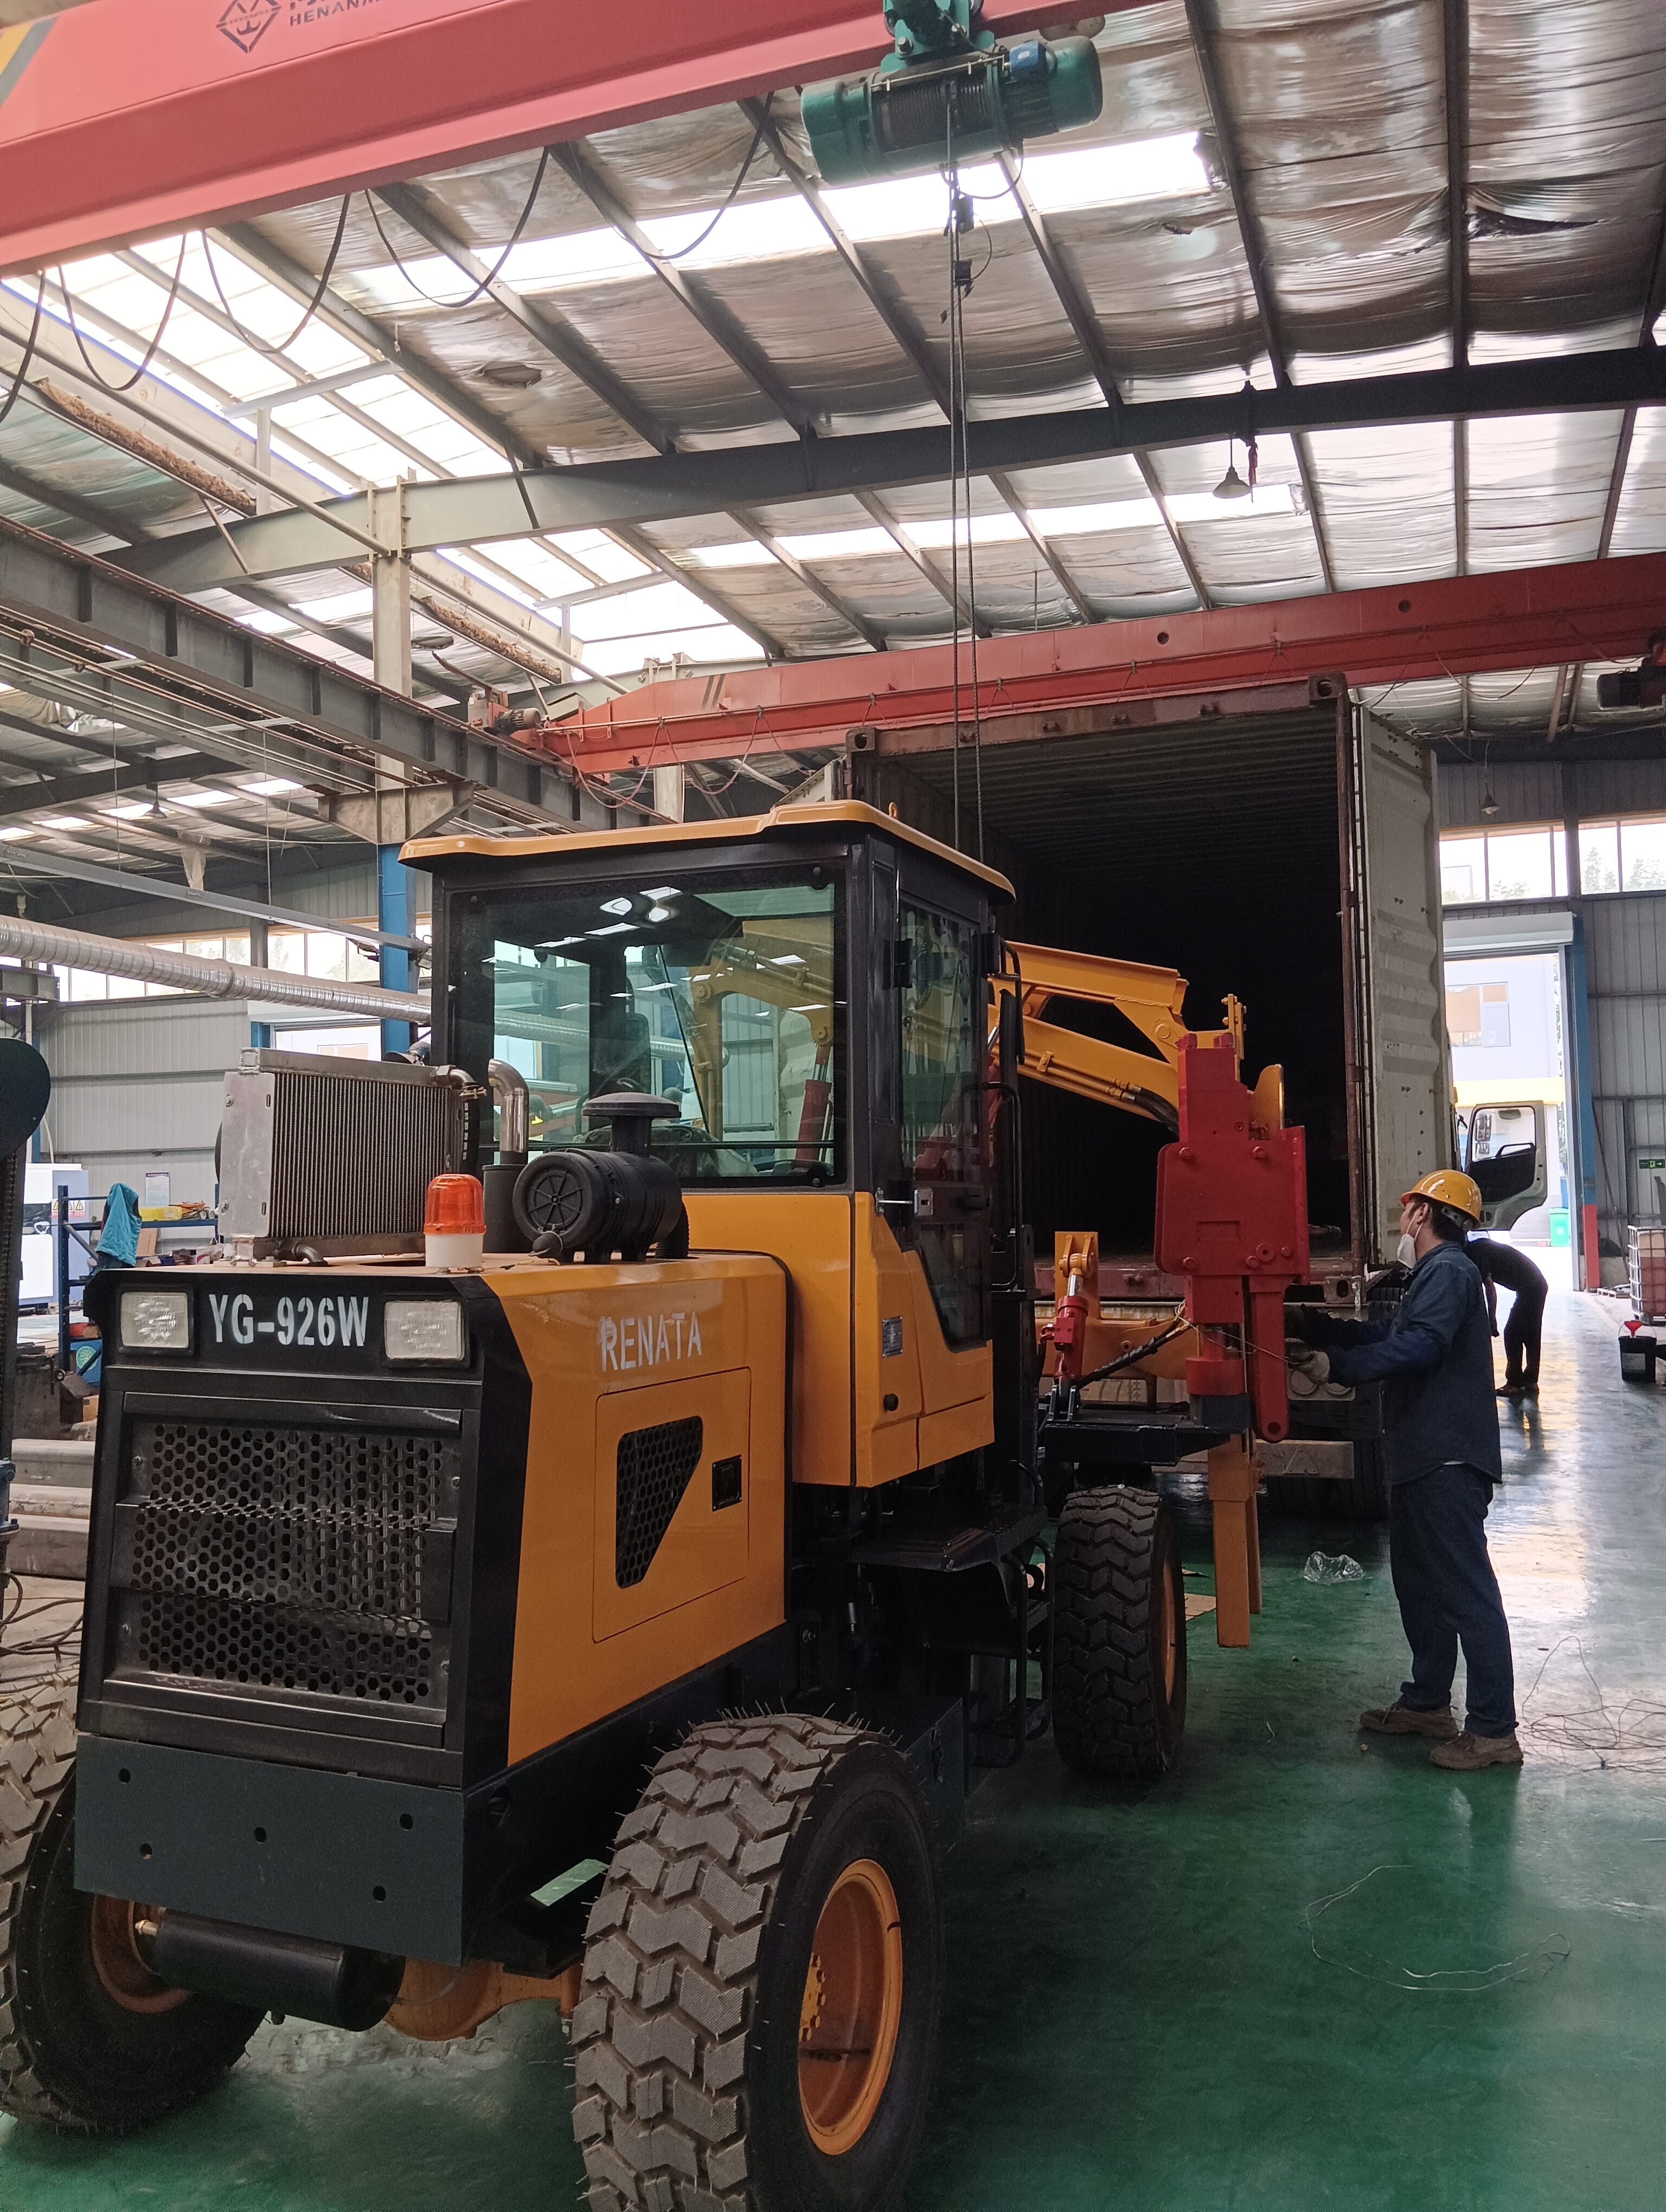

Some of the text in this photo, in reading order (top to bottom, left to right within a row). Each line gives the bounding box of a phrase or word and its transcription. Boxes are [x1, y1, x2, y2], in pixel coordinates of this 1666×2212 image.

[289, 0, 380, 26] HENAN
[209, 1294, 369, 1346] YG-926W
[598, 1310, 702, 1372] RENATA
